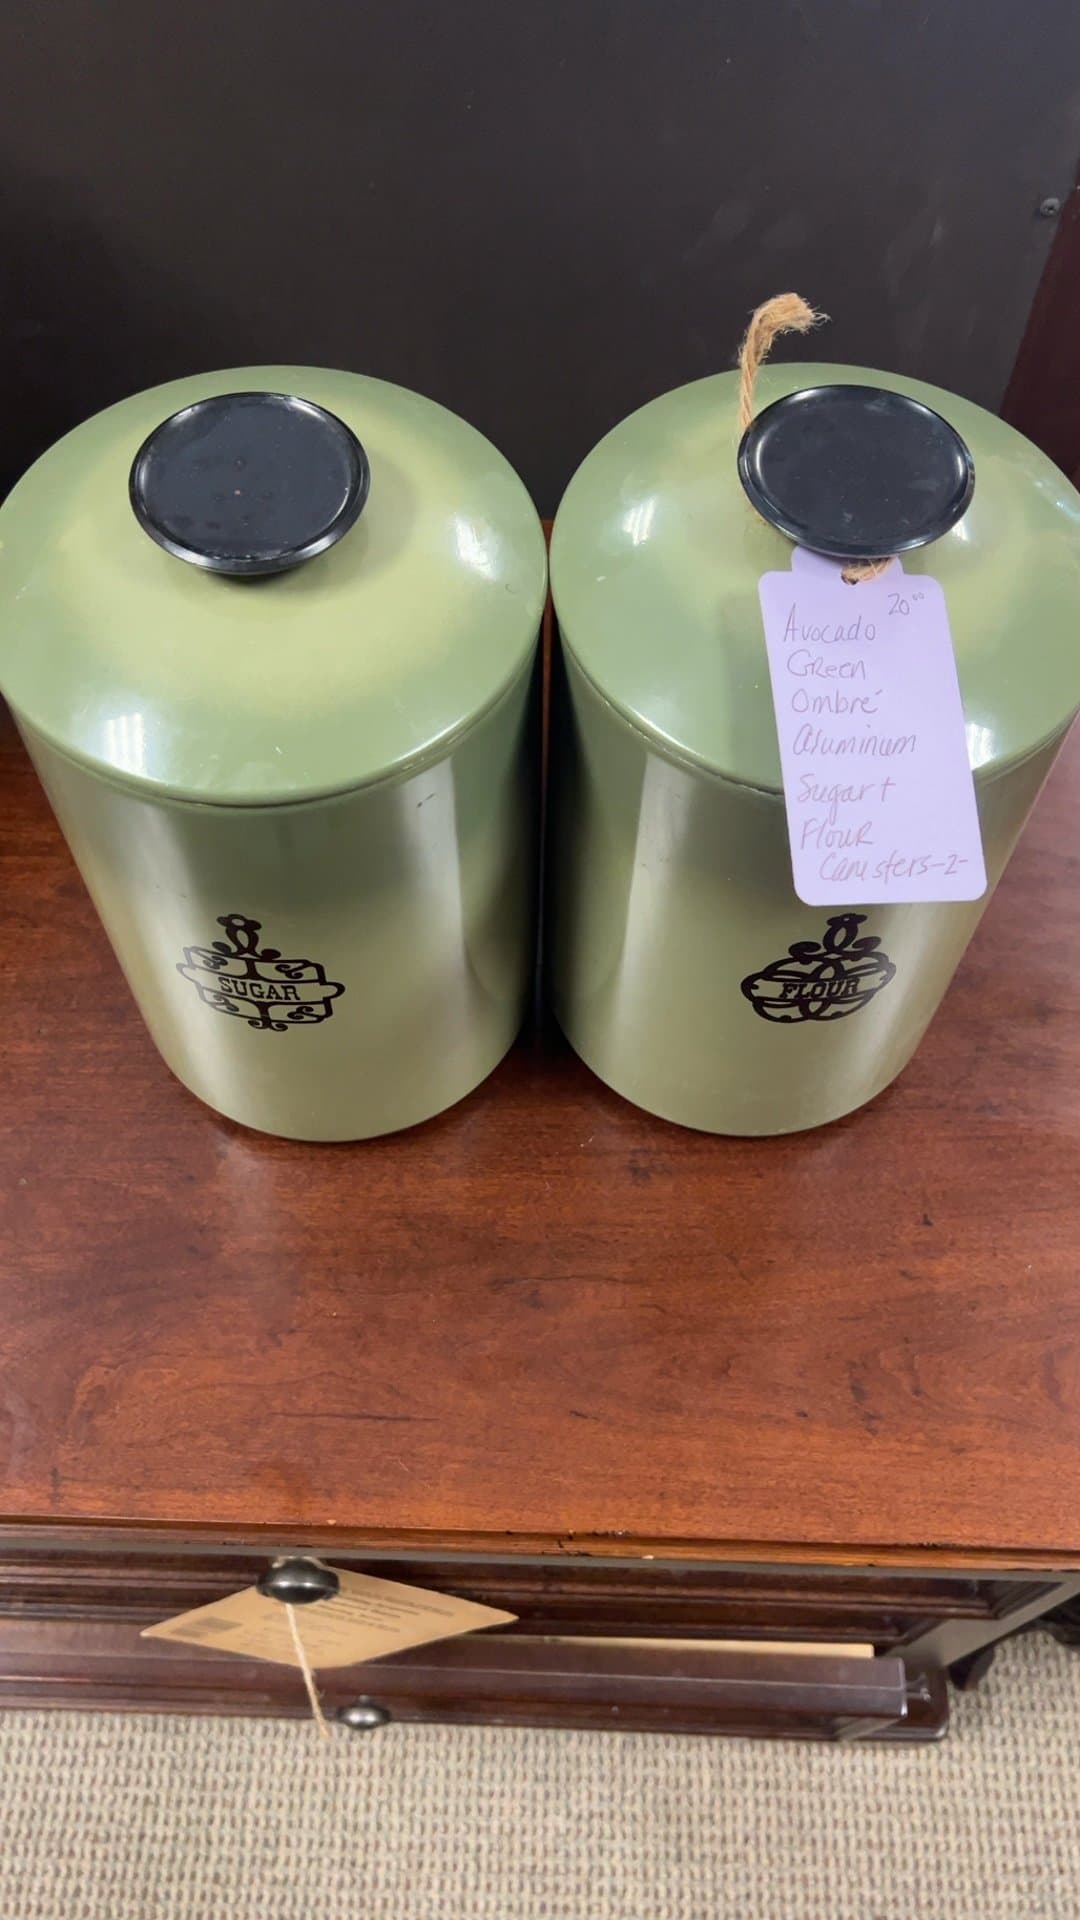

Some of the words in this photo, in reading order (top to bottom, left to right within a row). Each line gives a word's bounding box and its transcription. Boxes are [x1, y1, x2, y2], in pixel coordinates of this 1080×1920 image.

[783, 602, 876, 643] Avocado
[797, 773, 874, 825] Sugar
[218, 976, 300, 1001] SUGAR
[779, 975, 860, 1000] FLOUR
